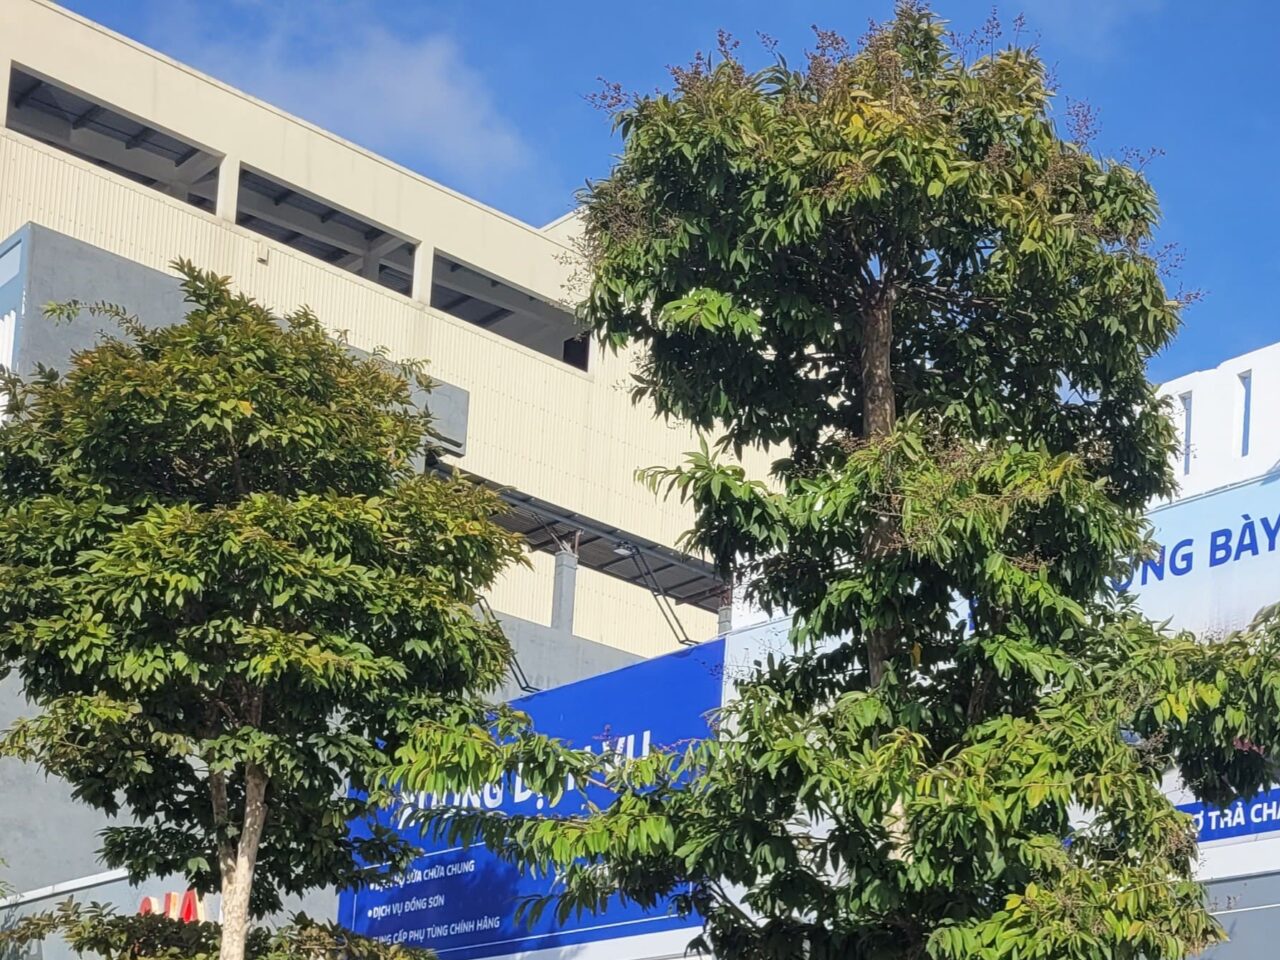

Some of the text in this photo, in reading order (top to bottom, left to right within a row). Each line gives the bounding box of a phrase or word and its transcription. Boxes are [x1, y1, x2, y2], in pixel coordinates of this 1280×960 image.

[1208, 801, 1245, 831] TRẢ
[446, 860, 475, 876] CHUNG
[373, 905, 391, 920] DỊCH
[392, 902, 403, 916] VỤ
[408, 929, 426, 943] PHỤ
[449, 919, 475, 935] CHÍNH
